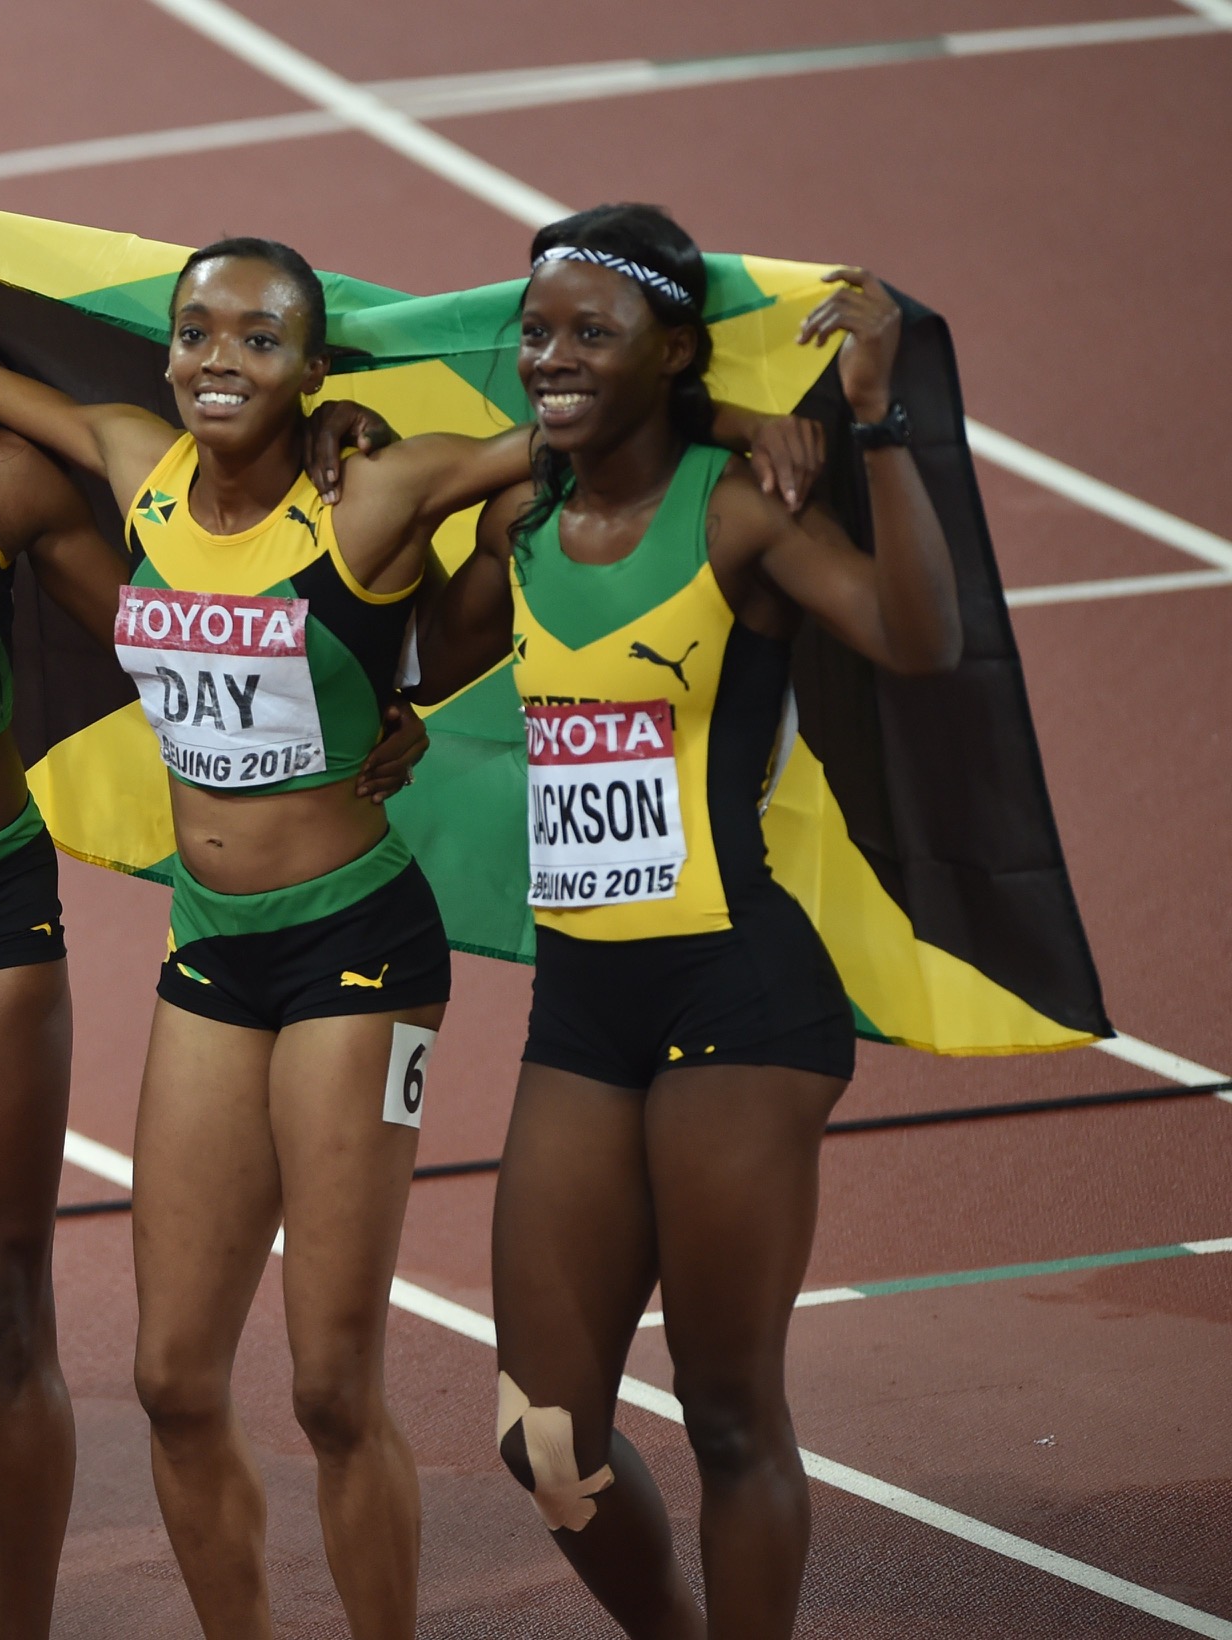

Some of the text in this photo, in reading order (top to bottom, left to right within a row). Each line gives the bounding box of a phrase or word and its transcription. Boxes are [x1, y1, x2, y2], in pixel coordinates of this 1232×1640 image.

[127, 598, 297, 648] TOYOTA
[155, 666, 261, 731] DAY
[161, 734, 314, 782] BEIJING 2015
[526, 711, 664, 757] TOYOTA
[532, 778, 669, 846] JACKSON
[532, 863, 677, 900] BEIJING 2015
[403, 1042, 426, 1114] 6
